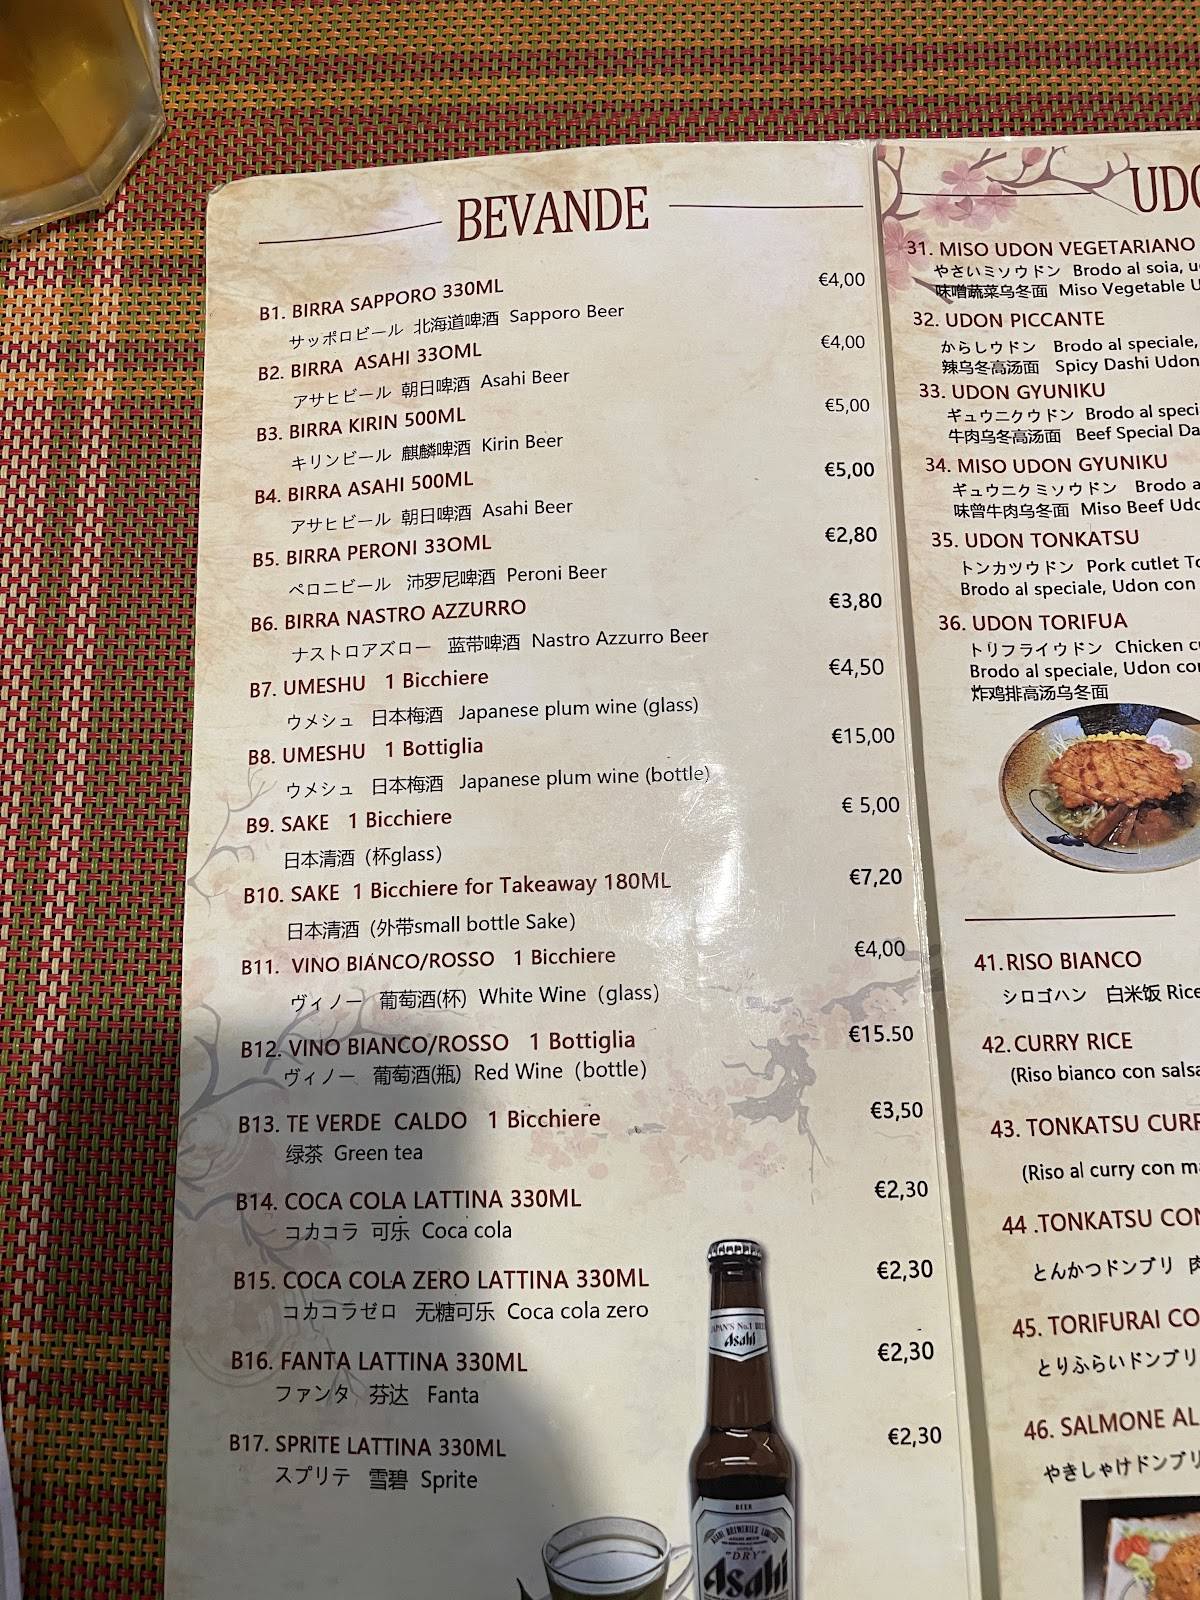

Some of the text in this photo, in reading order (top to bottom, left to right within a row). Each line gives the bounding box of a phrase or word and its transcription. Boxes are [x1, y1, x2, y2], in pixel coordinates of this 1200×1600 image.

[457, 186, 648, 242] BEVANDE
[940, 237, 1195, 257] MISO UDON VEGETARIANO
[1073, 261, 1183, 276] Brodo al soia,
[819, 272, 865, 288] €4,00
[1102, 279, 1185, 297] Vegetable
[260, 279, 503, 321] B1. BIRRA SAPPORO 330ML
[510, 309, 580, 325] Sapporo
[588, 305, 624, 318] Beer
[1011, 311, 1104, 327] PICCANTE
[821, 335, 865, 351] €4,00
[1054, 335, 1198, 353] Brodo al speciale,
[354, 350, 409, 371] ASAHI
[1056, 354, 1199, 375] Spicy Dashi Udon
[480, 371, 525, 388] Asahi
[1017, 382, 1105, 399] GYUNIKU
[825, 398, 869, 414] €5,00
[350, 407, 466, 433] KIRIN 500ML
[1076, 426, 1111, 441] Beef
[1116, 424, 1173, 443] Special
[483, 436, 518, 452] Kirin
[825, 462, 874, 479] €5,00
[958, 454, 1167, 473] MISO UDON GYUNIKU
[348, 471, 473, 496] ASAHI 500ML
[825, 527, 877, 544] €2,80
[965, 529, 1139, 548] UDON TONKATSU
[348, 540, 416, 560] PERONI
[508, 565, 561, 582] Peroni
[1087, 556, 1180, 573] Pork cutlet
[961, 578, 1195, 599] Brodo speciale, Udon con
[829, 593, 882, 611] €3,80
[286, 599, 526, 630] BIRRA NASTRO AZZURRO
[1038, 613, 1128, 630] TORIFUA
[533, 633, 589, 648] Nastro
[596, 631, 663, 645] Azzurro
[670, 629, 709, 643] Beer
[1116, 639, 1183, 653] Chicken
[829, 658, 884, 678] €4,50
[970, 664, 1019, 678] Brodo
[284, 670, 488, 695] UMESHU Bicchiere
[459, 705, 538, 723] Japanese
[546, 700, 589, 720] plum
[595, 699, 636, 714] wine
[644, 697, 698, 717] (glass)
[832, 728, 894, 746] €15,00
[403, 737, 483, 759] Bottiglia
[646, 765, 710, 785] (bottle)
[367, 809, 452, 828] Bicchiere
[244, 872, 671, 904] B10. SAKE Bicchiere for Takeaway 180ML
[849, 868, 902, 888] €7,20
[467, 914, 519, 931] bottle
[854, 939, 905, 960] €4,00
[292, 948, 615, 973] VINO Bicchiere
[1060, 951, 1141, 969] BIANCO
[479, 986, 586, 1004] White Wine
[289, 1030, 635, 1056] VINO BIANCO/ROSSO Bottiglia
[849, 1025, 913, 1043] €15.50
[1087, 1032, 1132, 1050] RICE
[475, 1062, 563, 1080] Red Wine
[1011, 1065, 1155, 1086] (Riso bianco con
[287, 1109, 600, 1132] TE VERDE CALDO Bicchiere
[870, 1101, 923, 1122] €3,50
[1026, 1115, 1139, 1136] TONKATSU
[335, 1145, 387, 1161] Green
[395, 1145, 422, 1160] tea
[1023, 1164, 1135, 1184] (Riso curry
[285, 1189, 581, 1210] COCA COLA LATTINA 330ML
[874, 1180, 928, 1201] €2,30
[423, 1222, 467, 1239] Coca
[475, 1220, 511, 1238] cola
[284, 1268, 649, 1289] COCA COLA ZERO LATTINA 330ML
[877, 1259, 933, 1282] €2,30
[606, 1305, 648, 1318] zero
[1048, 1309, 1160, 1335] TORIFURAI
[724, 1331, 756, 1348] Asahi
[282, 1352, 448, 1371] FANTA LATTINA
[877, 1341, 934, 1364] €2,30
[429, 1386, 478, 1403] Fanta
[1061, 1409, 1165, 1437] SALMONE
[276, 1435, 431, 1456] SPRITE LATTINA
[888, 1426, 941, 1448] €2,30
[421, 1470, 477, 1494] Sprite
[703, 1547, 788, 1599] Asahi
